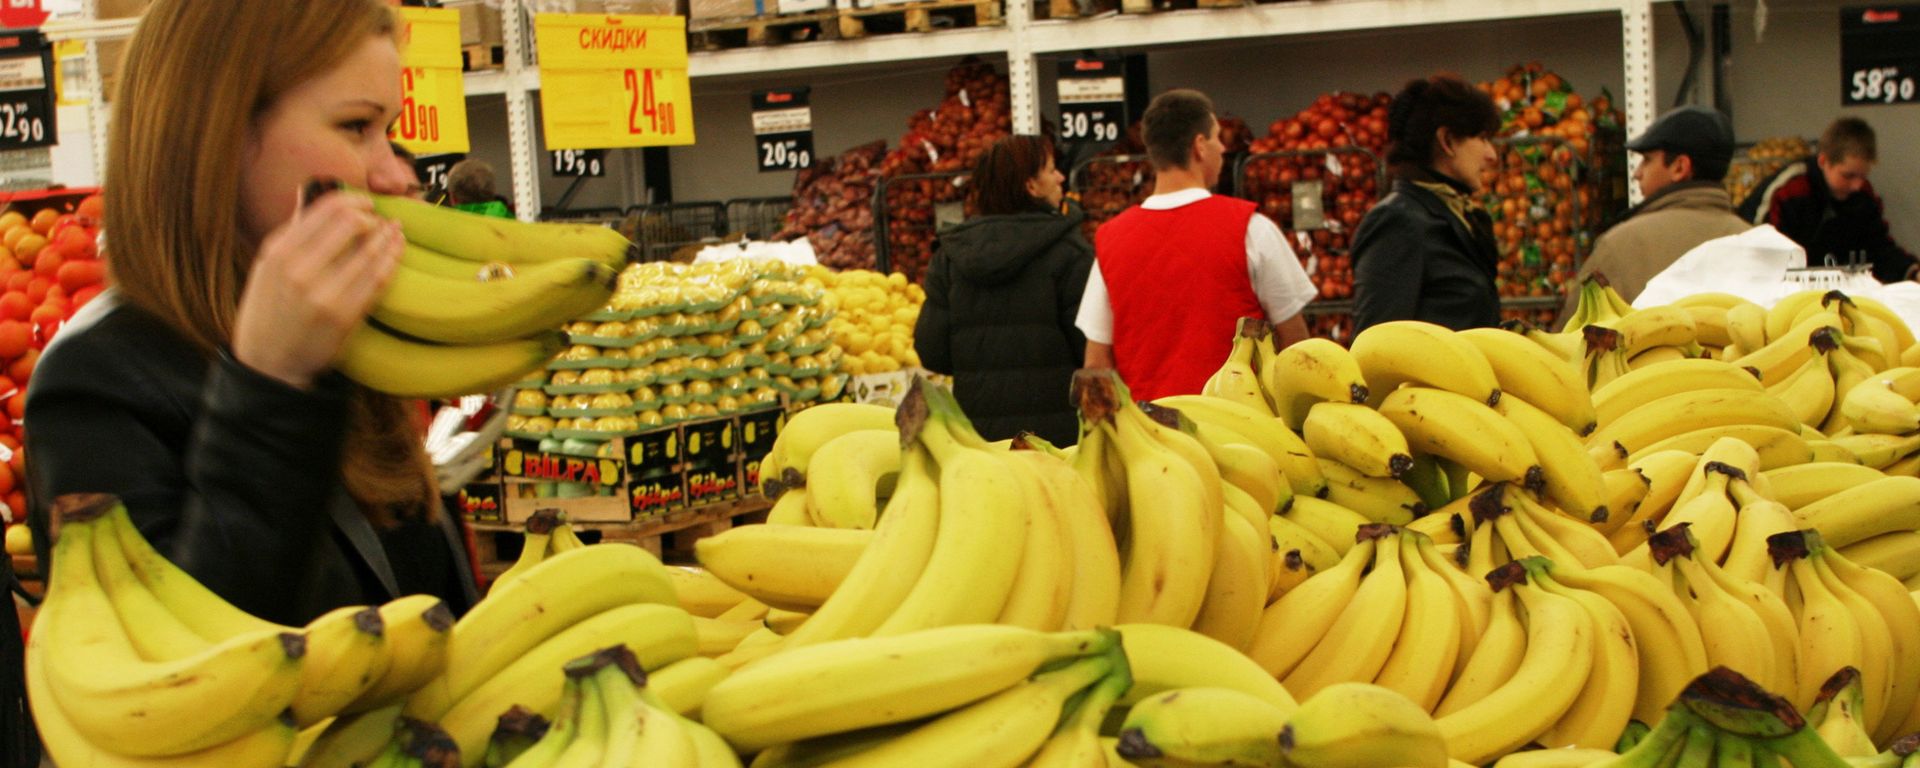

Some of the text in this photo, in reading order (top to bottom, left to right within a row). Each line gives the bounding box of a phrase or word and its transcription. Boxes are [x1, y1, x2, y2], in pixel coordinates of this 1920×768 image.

[579, 27, 647, 52] СКИДКИ
[1851, 68, 1915, 103] 58 90
[624, 68, 676, 135] 24 90
[18, 117, 44, 142] 90
[418, 104, 439, 142] 90
[1062, 112, 1118, 141] 30 90
[554, 149, 601, 175] 19 90
[762, 141, 810, 169] 20 90
[632, 482, 682, 511] Bilpa
